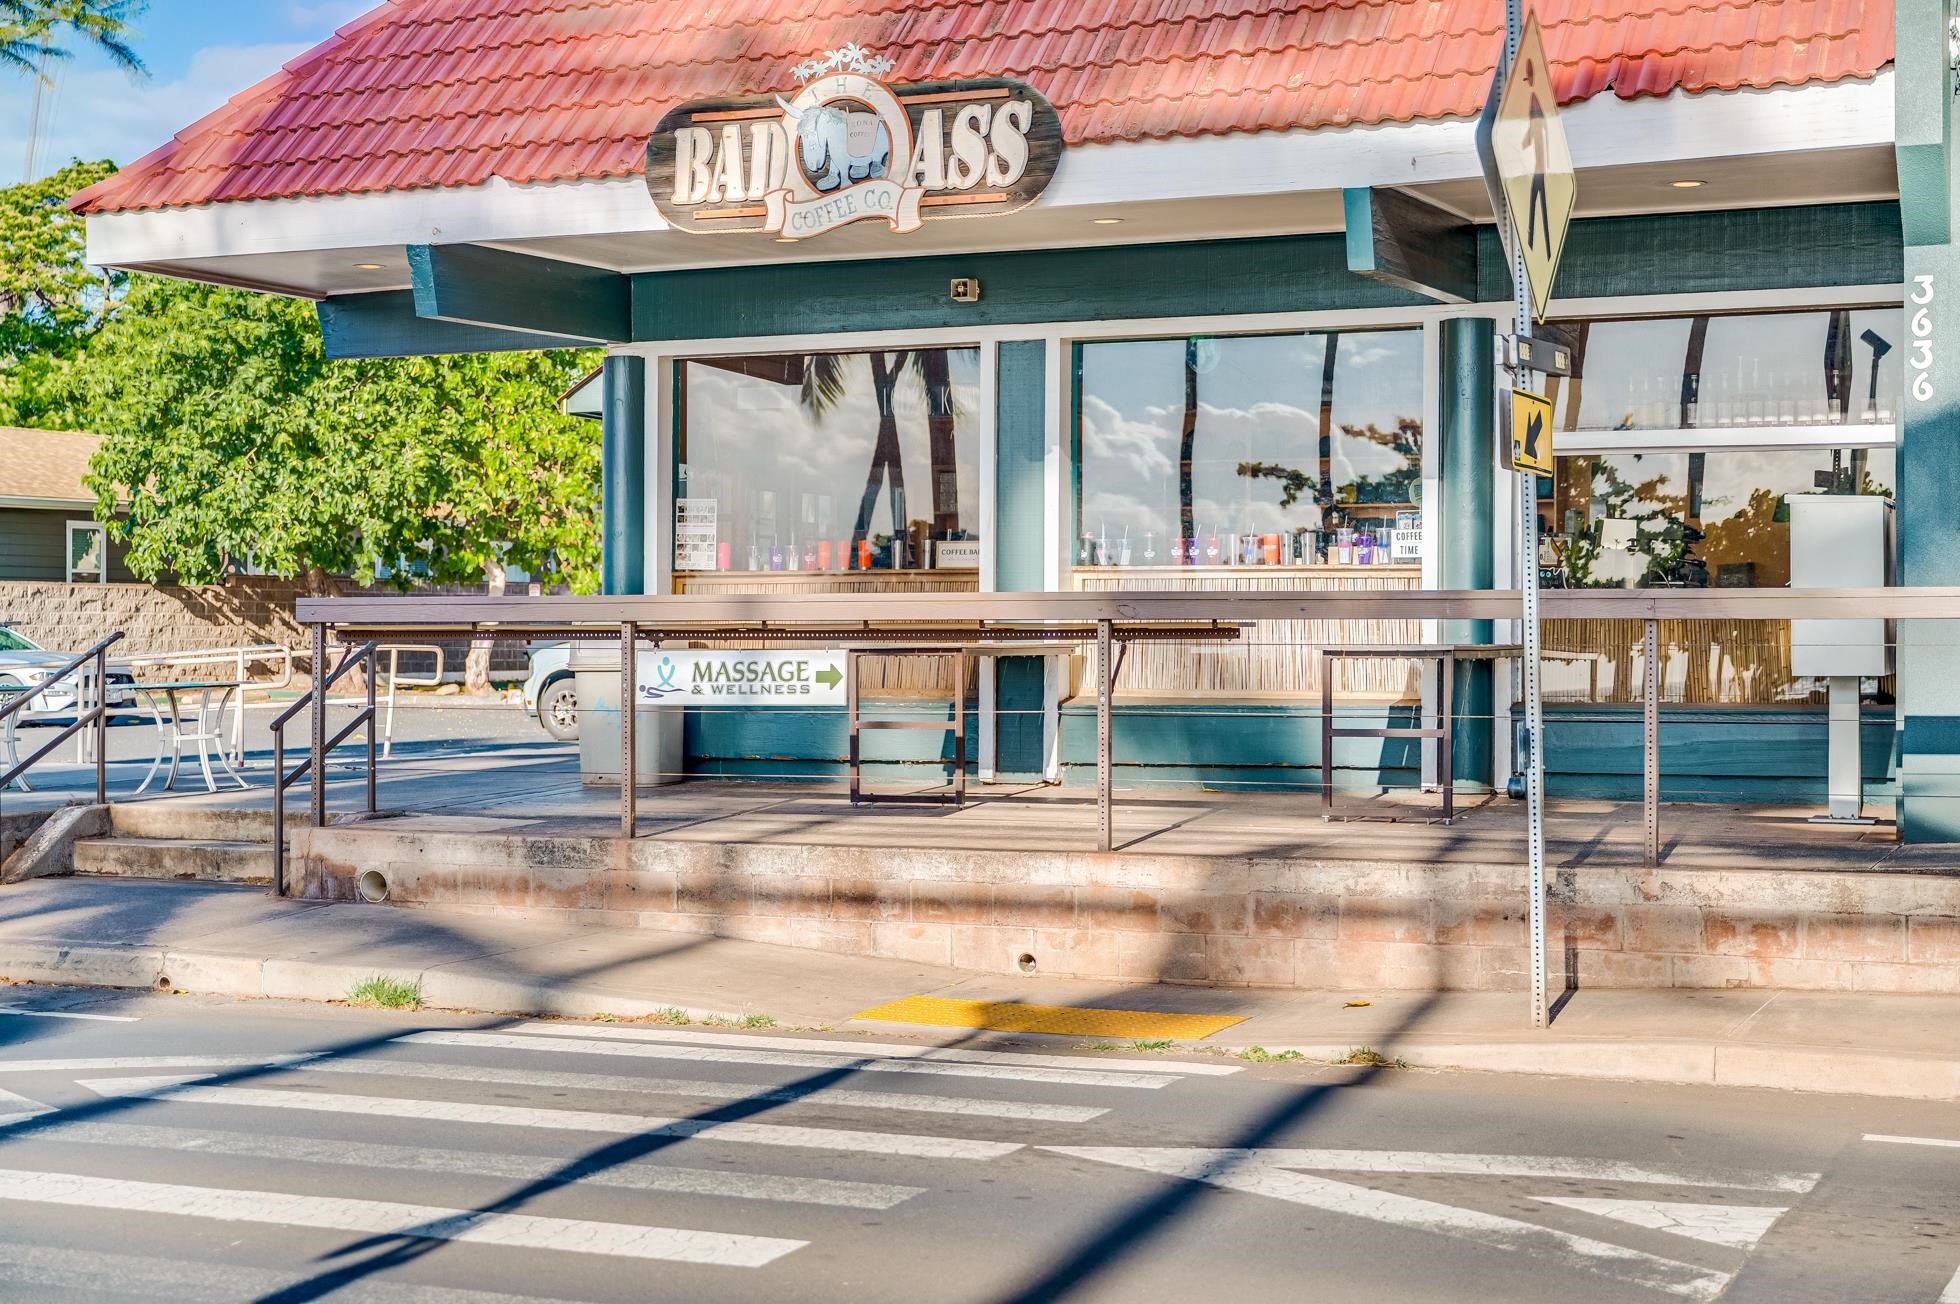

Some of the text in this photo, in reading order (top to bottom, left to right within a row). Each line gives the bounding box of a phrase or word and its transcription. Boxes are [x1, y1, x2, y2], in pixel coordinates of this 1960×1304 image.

[672, 100, 1033, 205] BAD ASS
[791, 188, 893, 231] COFFEE CO.
[1910, 275, 1934, 401] 3636
[1396, 532, 1423, 541] COFFEE
[941, 548, 968, 556] COFFEE
[1400, 545, 1419, 555] TIME
[692, 660, 809, 683] MASSAGE
[691, 684, 811, 695] & WELLNESS
